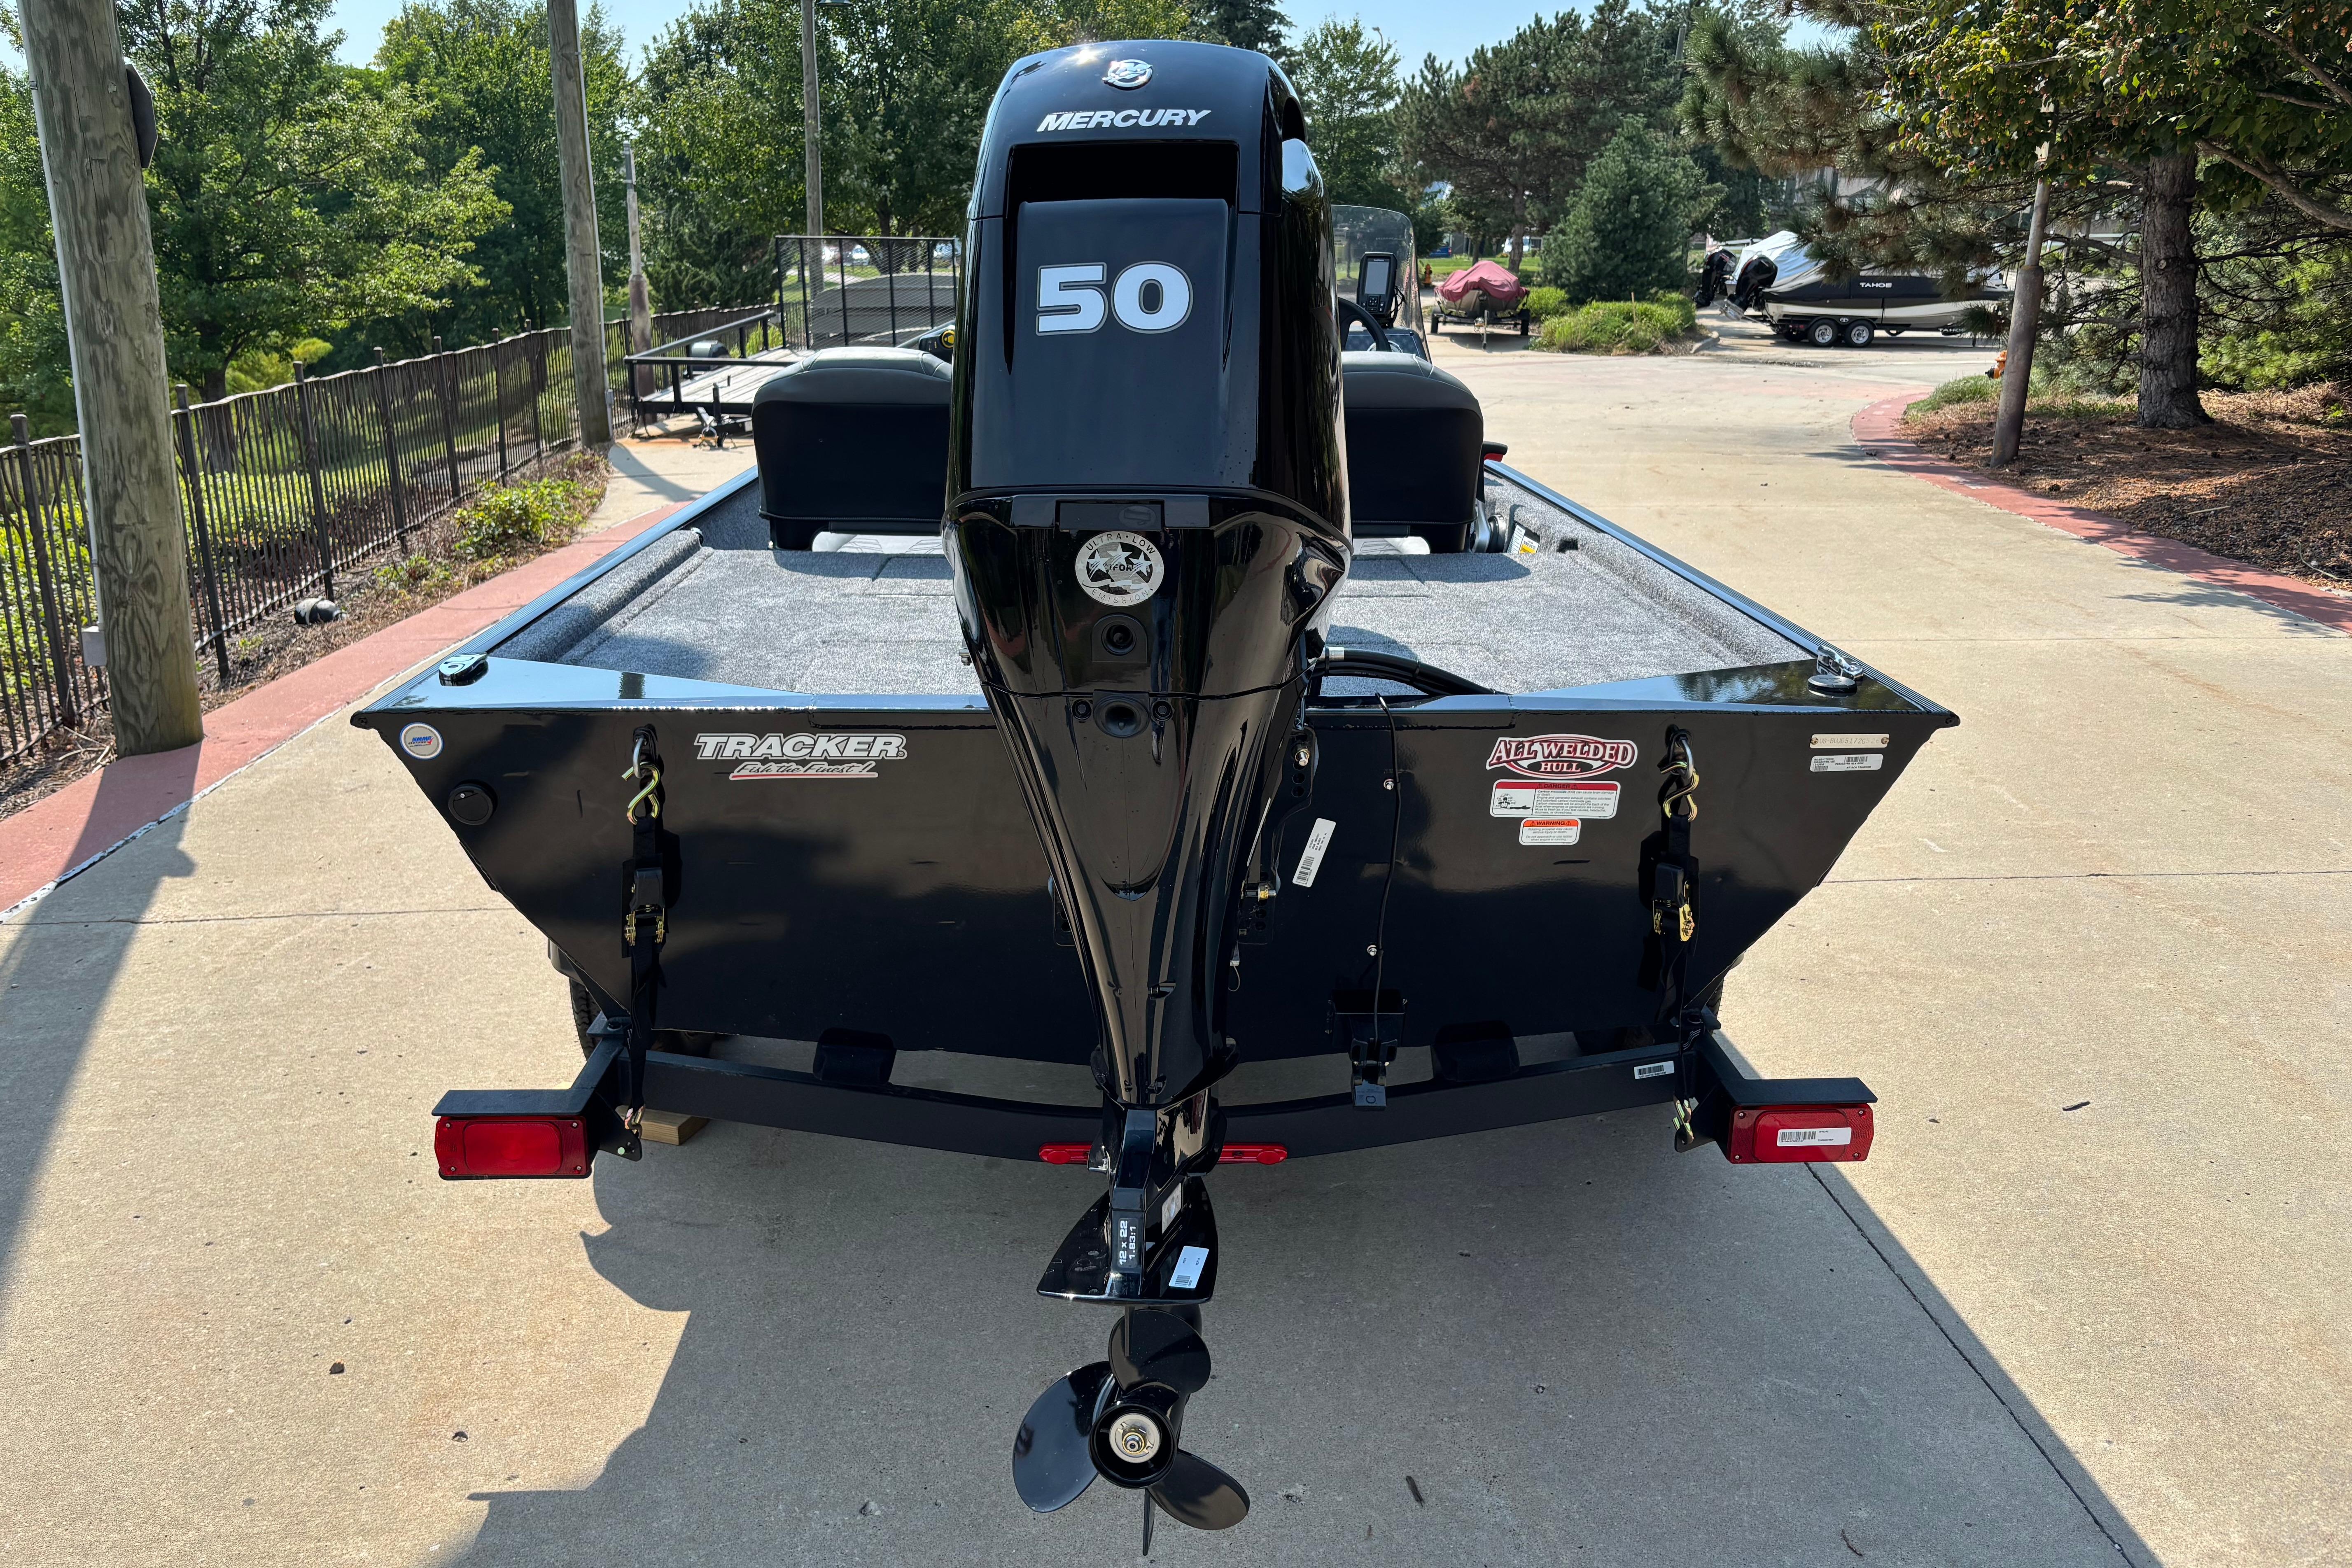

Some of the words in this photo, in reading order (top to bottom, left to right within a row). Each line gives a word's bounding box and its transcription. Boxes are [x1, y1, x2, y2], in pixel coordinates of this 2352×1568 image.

[1037, 110, 1211, 133] MERCURY
[1036, 261, 1193, 335] 50
[1086, 533, 1122, 551] ULTRA
[1132, 536, 1156, 555] LOW
[1092, 588, 1150, 604] EMISSION
[696, 735, 903, 759] TRACKER
[1489, 740, 1537, 767] ALL
[1540, 741, 1636, 766] WELDED
[736, 762, 772, 774] Fish
[776, 762, 801, 774] the
[1539, 762, 1581, 772] HULL
[1120, 1220, 1128, 1238] 22
[1119, 1250, 1127, 1265] 12
